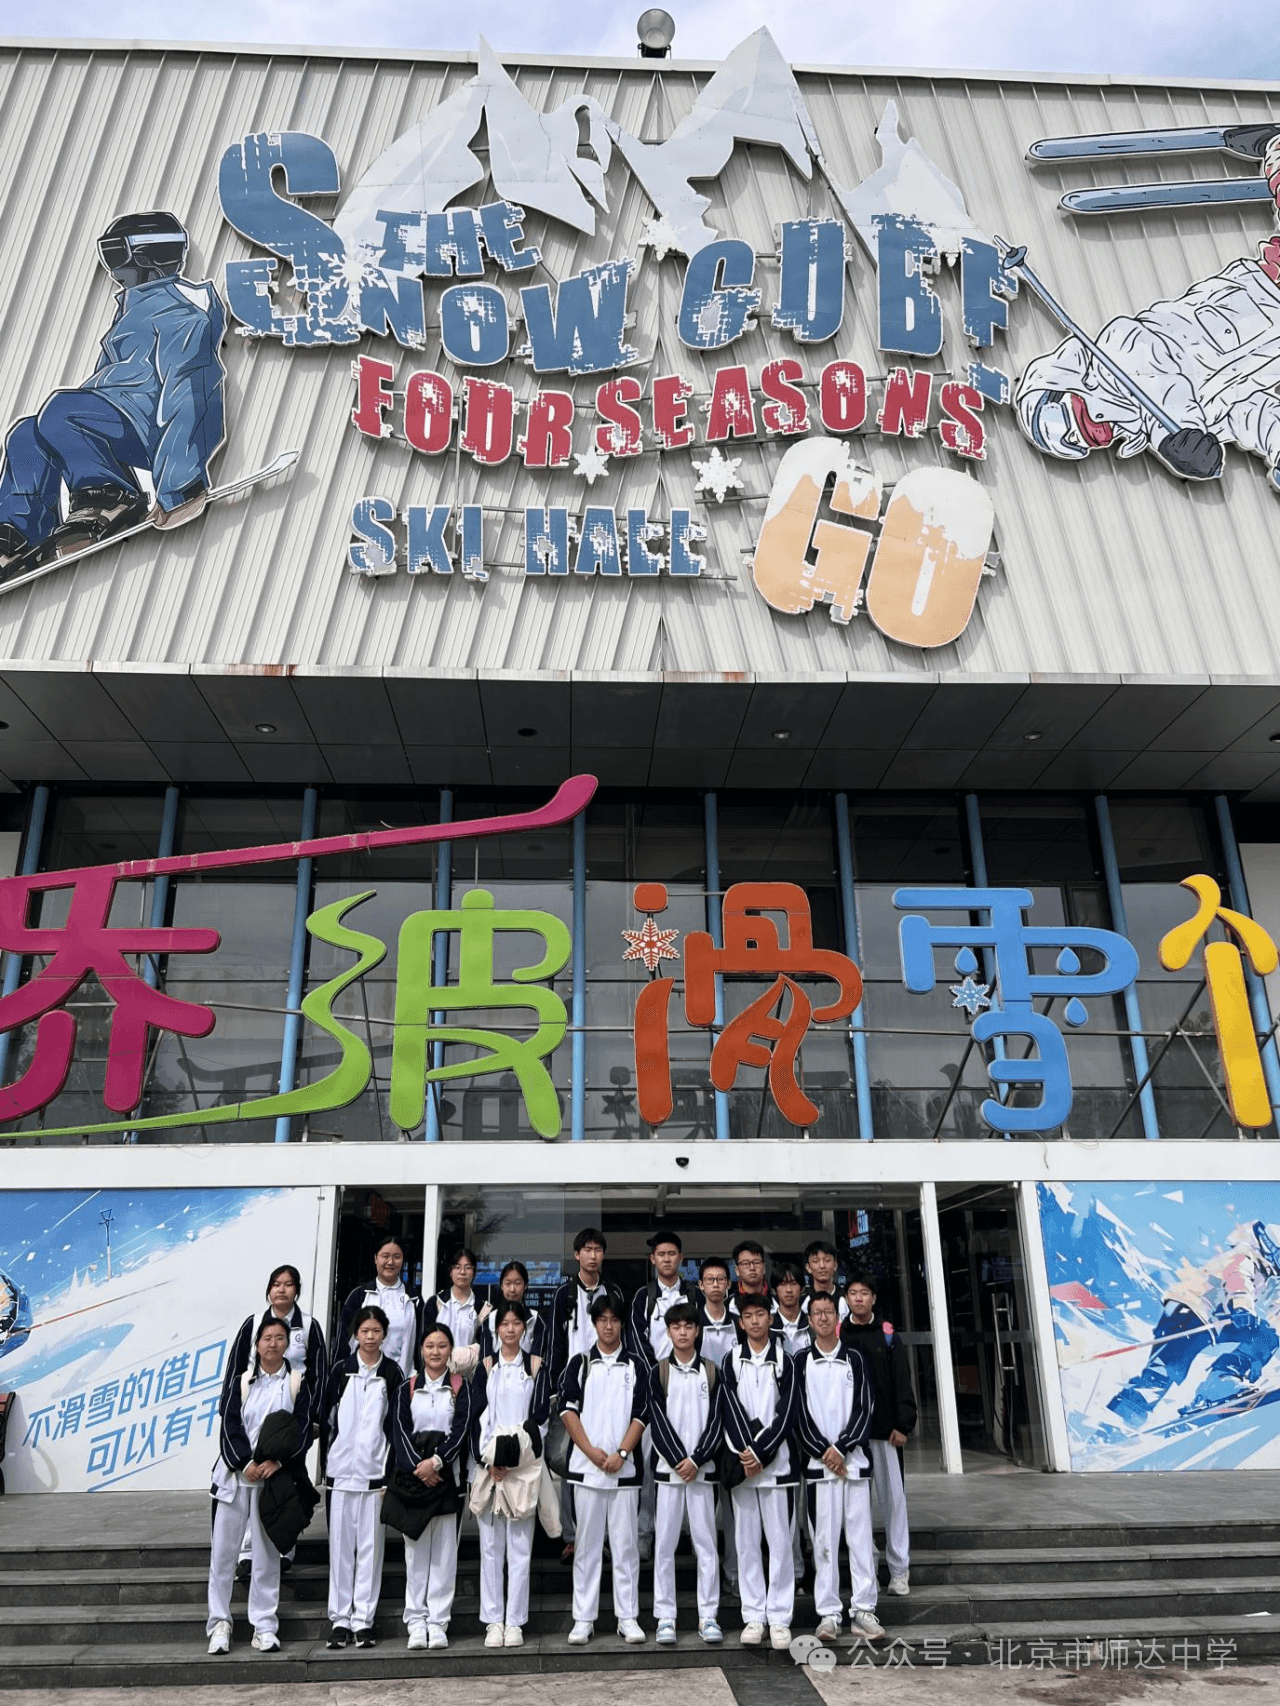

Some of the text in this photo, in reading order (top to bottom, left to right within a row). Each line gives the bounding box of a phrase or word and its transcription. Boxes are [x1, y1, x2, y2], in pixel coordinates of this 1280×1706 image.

[218, 130, 642, 376] SNOW
[374, 200, 540, 275] THE
[351, 355, 988, 467] FOUR SEASONS
[349, 496, 707, 582] SKI HALL
[752, 436, 997, 649] GO
[22, 1339, 228, 1448] 不滑雪的借口
